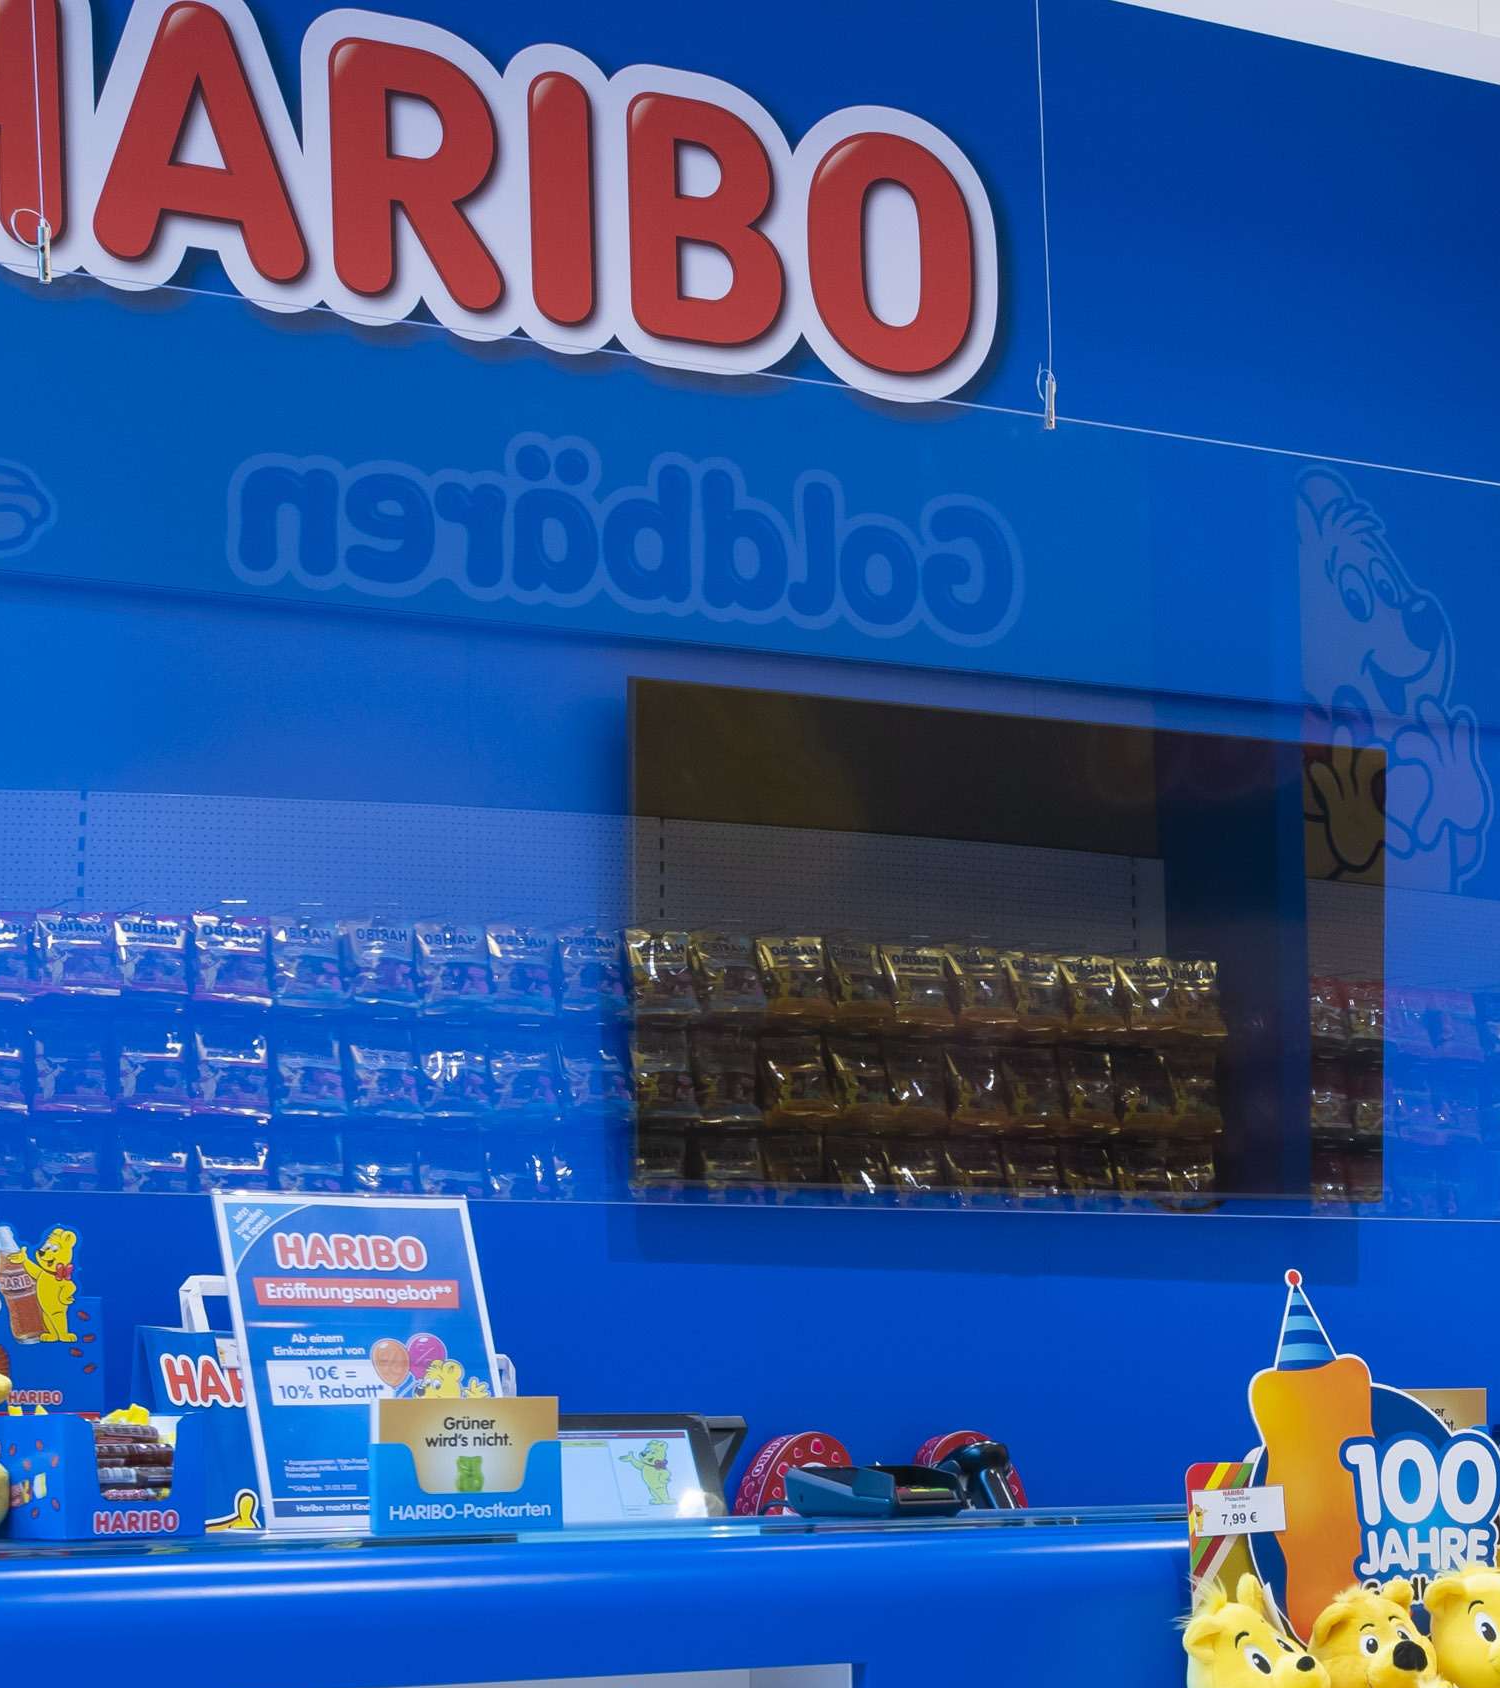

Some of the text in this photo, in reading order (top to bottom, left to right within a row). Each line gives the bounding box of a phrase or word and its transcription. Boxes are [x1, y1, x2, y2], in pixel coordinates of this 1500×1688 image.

[274, 1234, 426, 1270] HARIBO
[291, 1334, 343, 1343] Ab einem
[273, 1346, 365, 1357] Einkaufswert von
[306, 1366, 339, 1383] 10€
[8, 1391, 62, 1405] HARIBO
[278, 1384, 313, 1400] 10%
[444, 1416, 495, 1433] Grüner
[473, 1433, 513, 1447] nicht.
[1345, 1440, 1498, 1526] 100
[389, 1503, 551, 1521] HARIBO-Postkarten
[1222, 1512, 1258, 1526] 7,99 €
[94, 1511, 179, 1533] HARIBO
[1361, 1527, 1491, 1575] JAHRE
